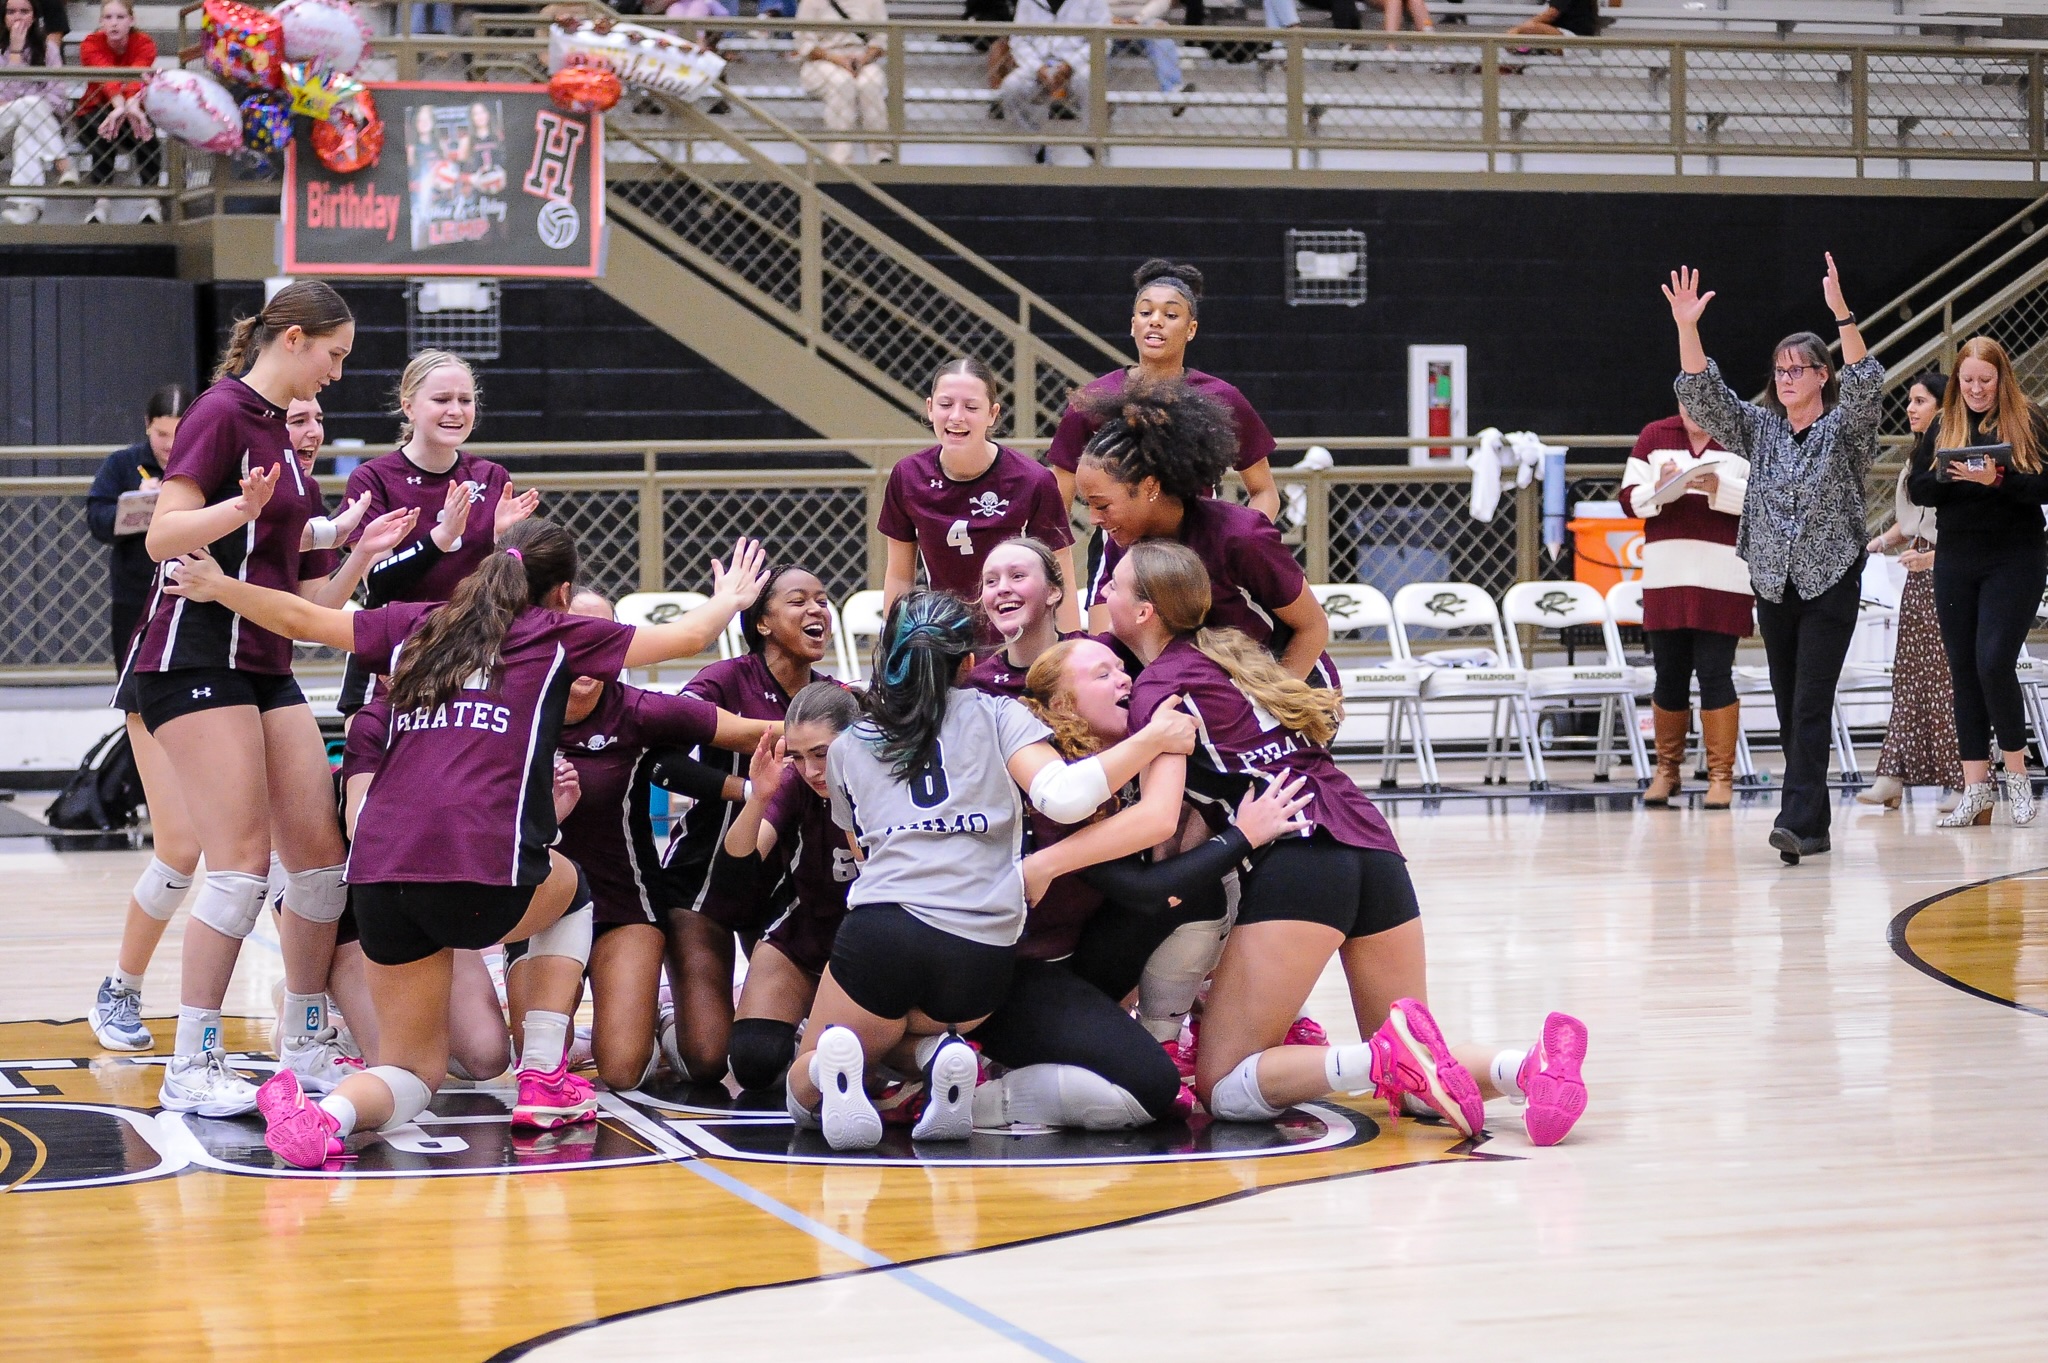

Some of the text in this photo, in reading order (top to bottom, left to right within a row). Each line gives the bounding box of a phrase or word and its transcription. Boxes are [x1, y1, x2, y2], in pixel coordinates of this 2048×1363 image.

[523, 110, 585, 202] H
[307, 181, 400, 242] Birthday
[946, 519, 974, 556] 4
[832, 847, 858, 882] 6
